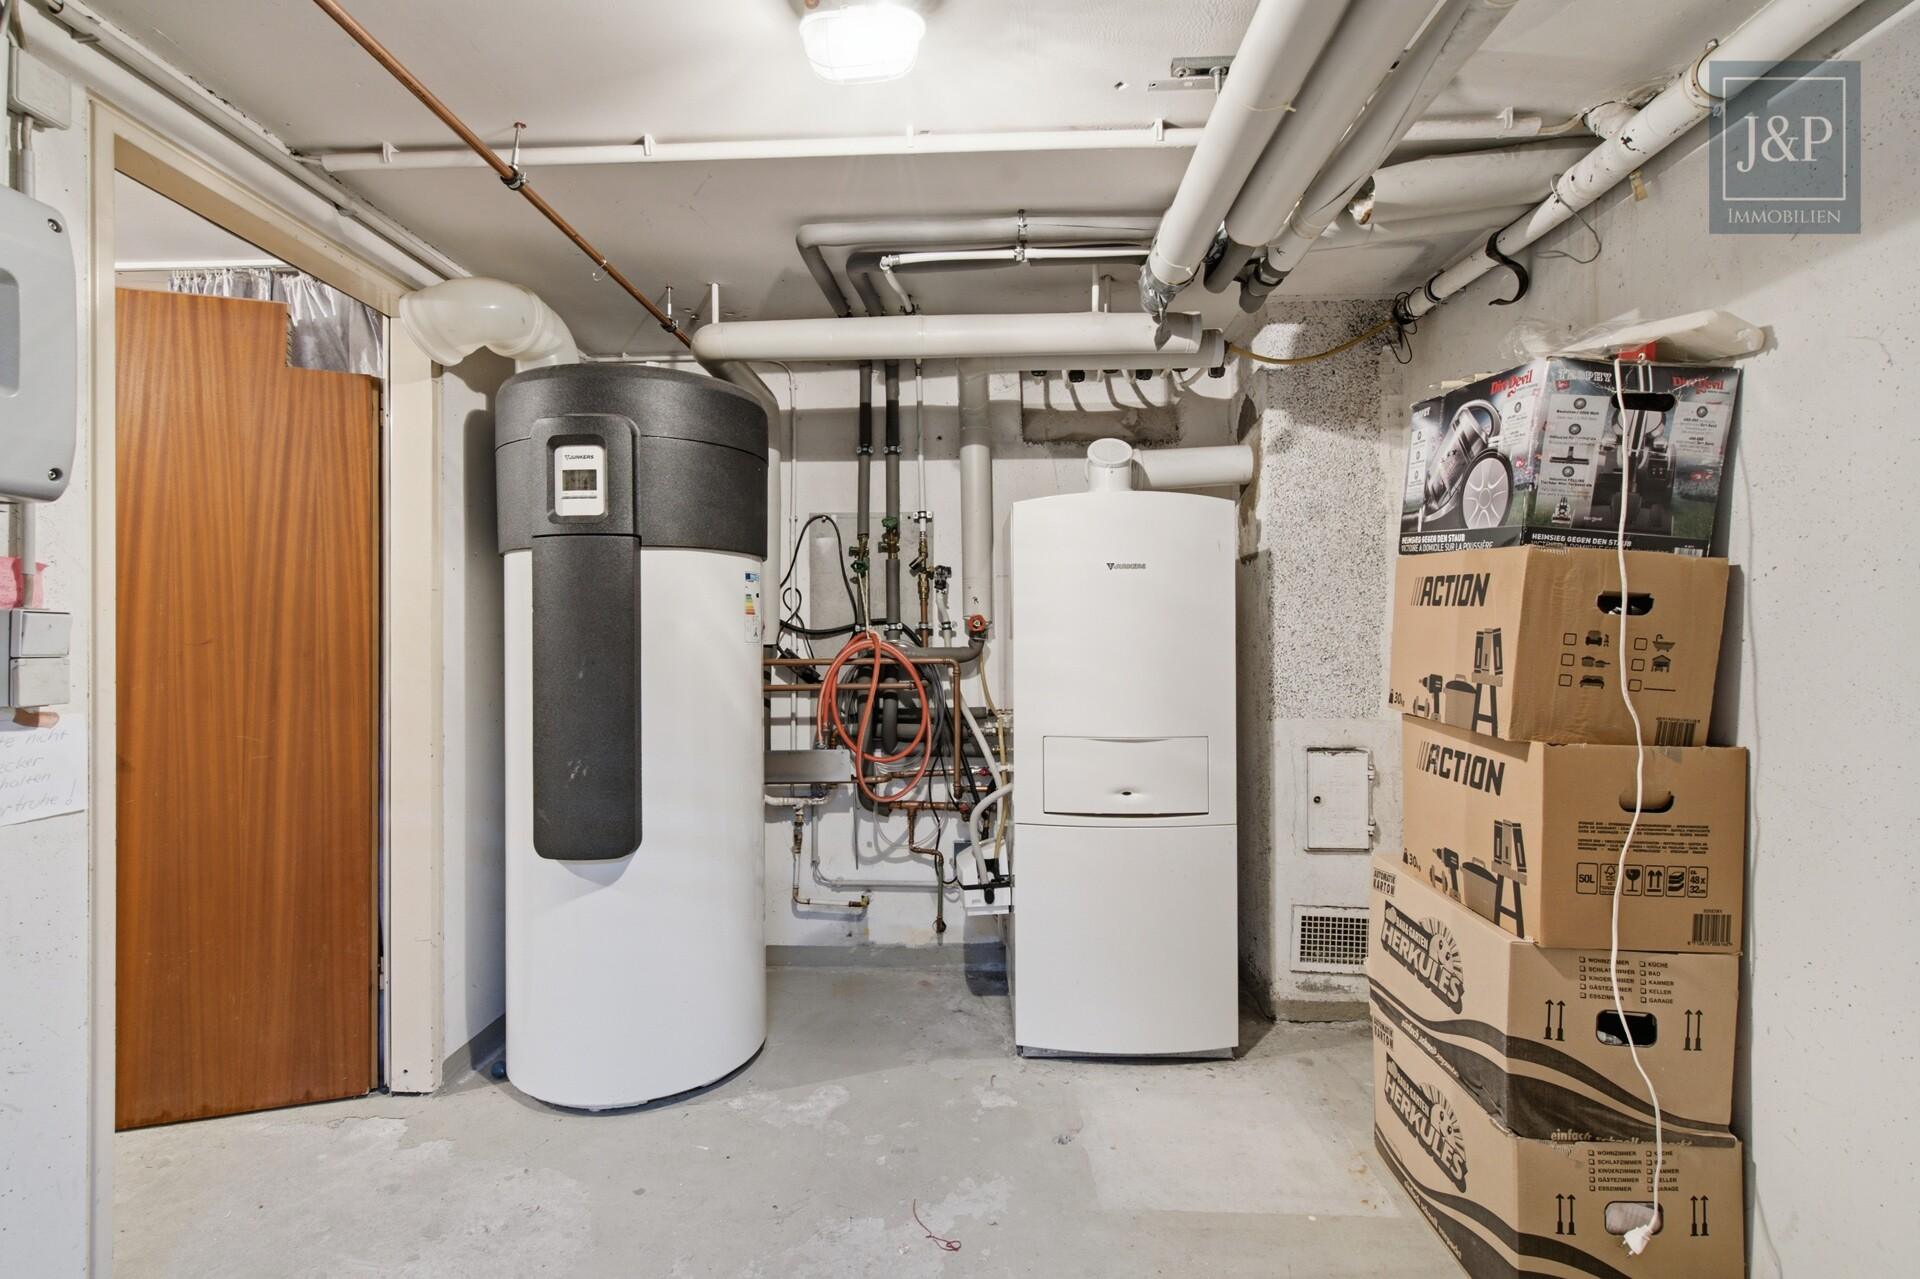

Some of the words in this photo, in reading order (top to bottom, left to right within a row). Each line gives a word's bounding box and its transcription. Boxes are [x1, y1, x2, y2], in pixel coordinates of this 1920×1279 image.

[1508, 369, 1533, 389] Devil
[1445, 543, 1455, 551] SUR
[1448, 533, 1466, 543] STAUB
[1532, 533, 1566, 542] HEIMSIEG
[1567, 536, 1592, 545] GEGEN
[1592, 538, 1607, 546] DEN
[1608, 539, 1632, 547] STUB
[1420, 572, 1491, 607] ACTION
[1425, 743, 1506, 797] ACTION
[1373, 879, 1396, 897] KARTON
[1578, 873, 1595, 884] 50L
[1381, 920, 1463, 1006] HERKULES
[1384, 1073, 1466, 1183] HERKULES
